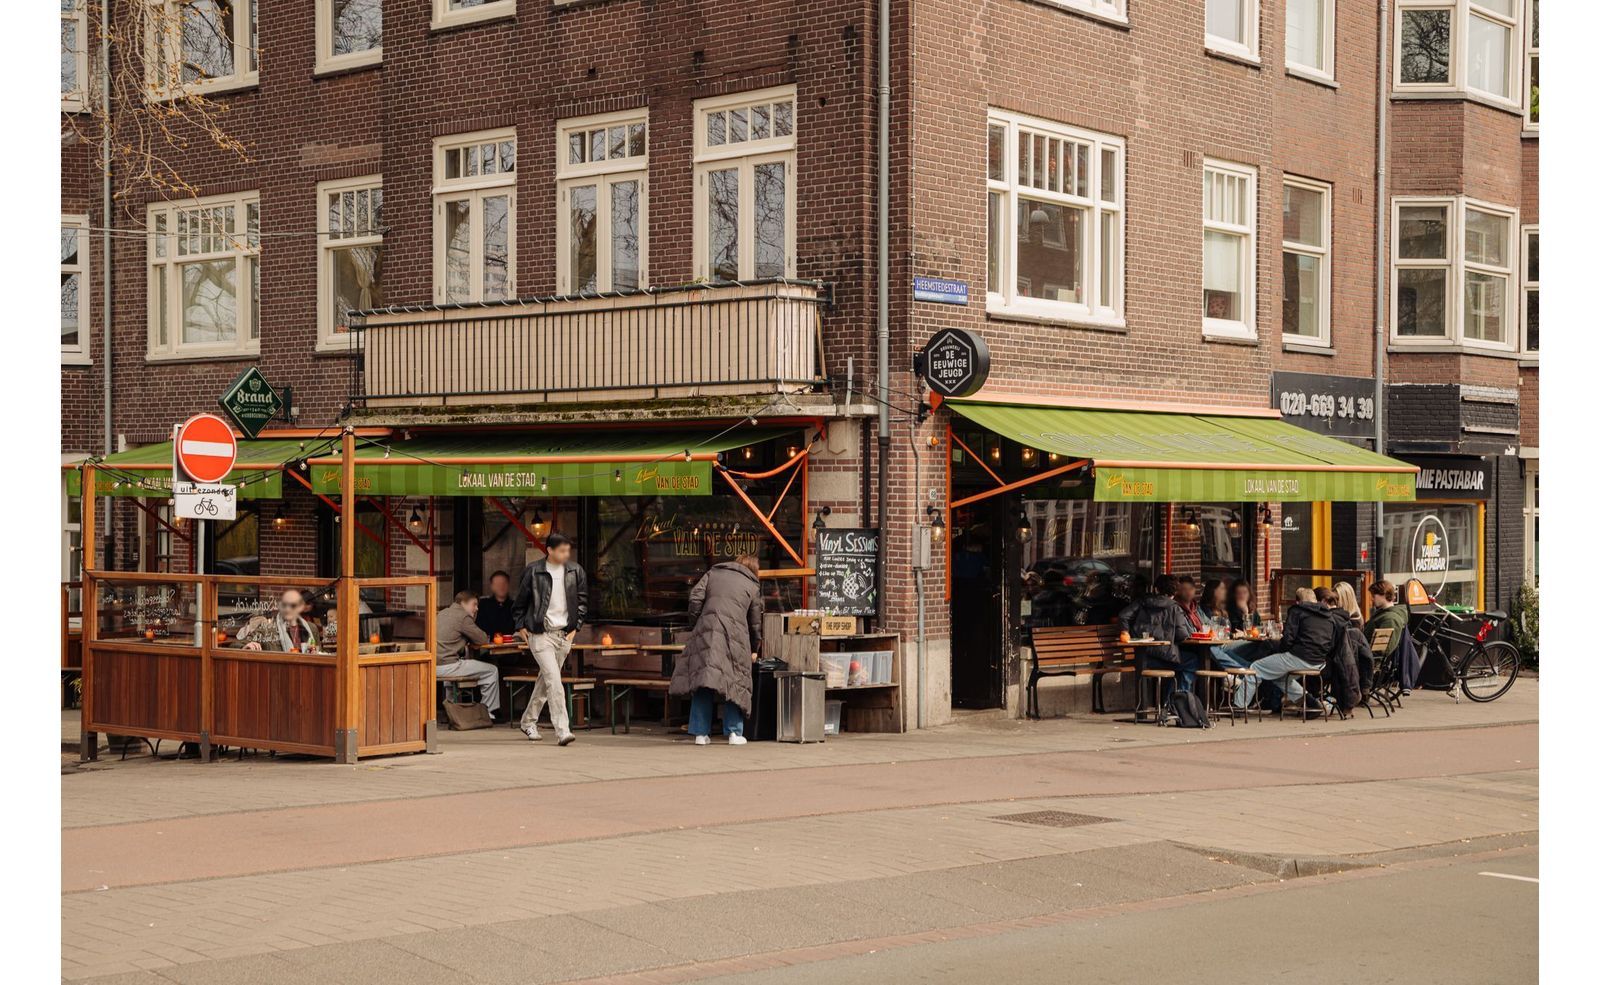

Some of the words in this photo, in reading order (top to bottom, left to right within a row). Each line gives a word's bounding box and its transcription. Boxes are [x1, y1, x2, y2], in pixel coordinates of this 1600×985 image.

[916, 279, 967, 295] HEEMSTEDESTRAAT
[945, 350, 955, 359] DE
[933, 358, 967, 370] EEUWIGE
[938, 368, 963, 379] JEUGD
[237, 389, 273, 404] Brand
[1280, 391, 1335, 418] 020-669
[1337, 395, 1354, 418] 34
[488, 473, 504, 488] VAN
[505, 472, 515, 487] DE
[516, 472, 536, 487] STAD
[656, 474, 670, 489] VAN
[671, 475, 681, 489] DE
[682, 475, 699, 489] STAD
[1245, 479, 1265, 493] LOKAAL
[1265, 479, 1277, 493] VAN
[1277, 479, 1285, 493] DE
[1285, 479, 1298, 493] STAD
[1434, 469, 1484, 491] PASTABAR
[673, 529, 700, 556] VAN
[703, 531, 721, 557] DE
[724, 530, 758, 557] STAD
[1415, 557, 1446, 572] PASTABAR
